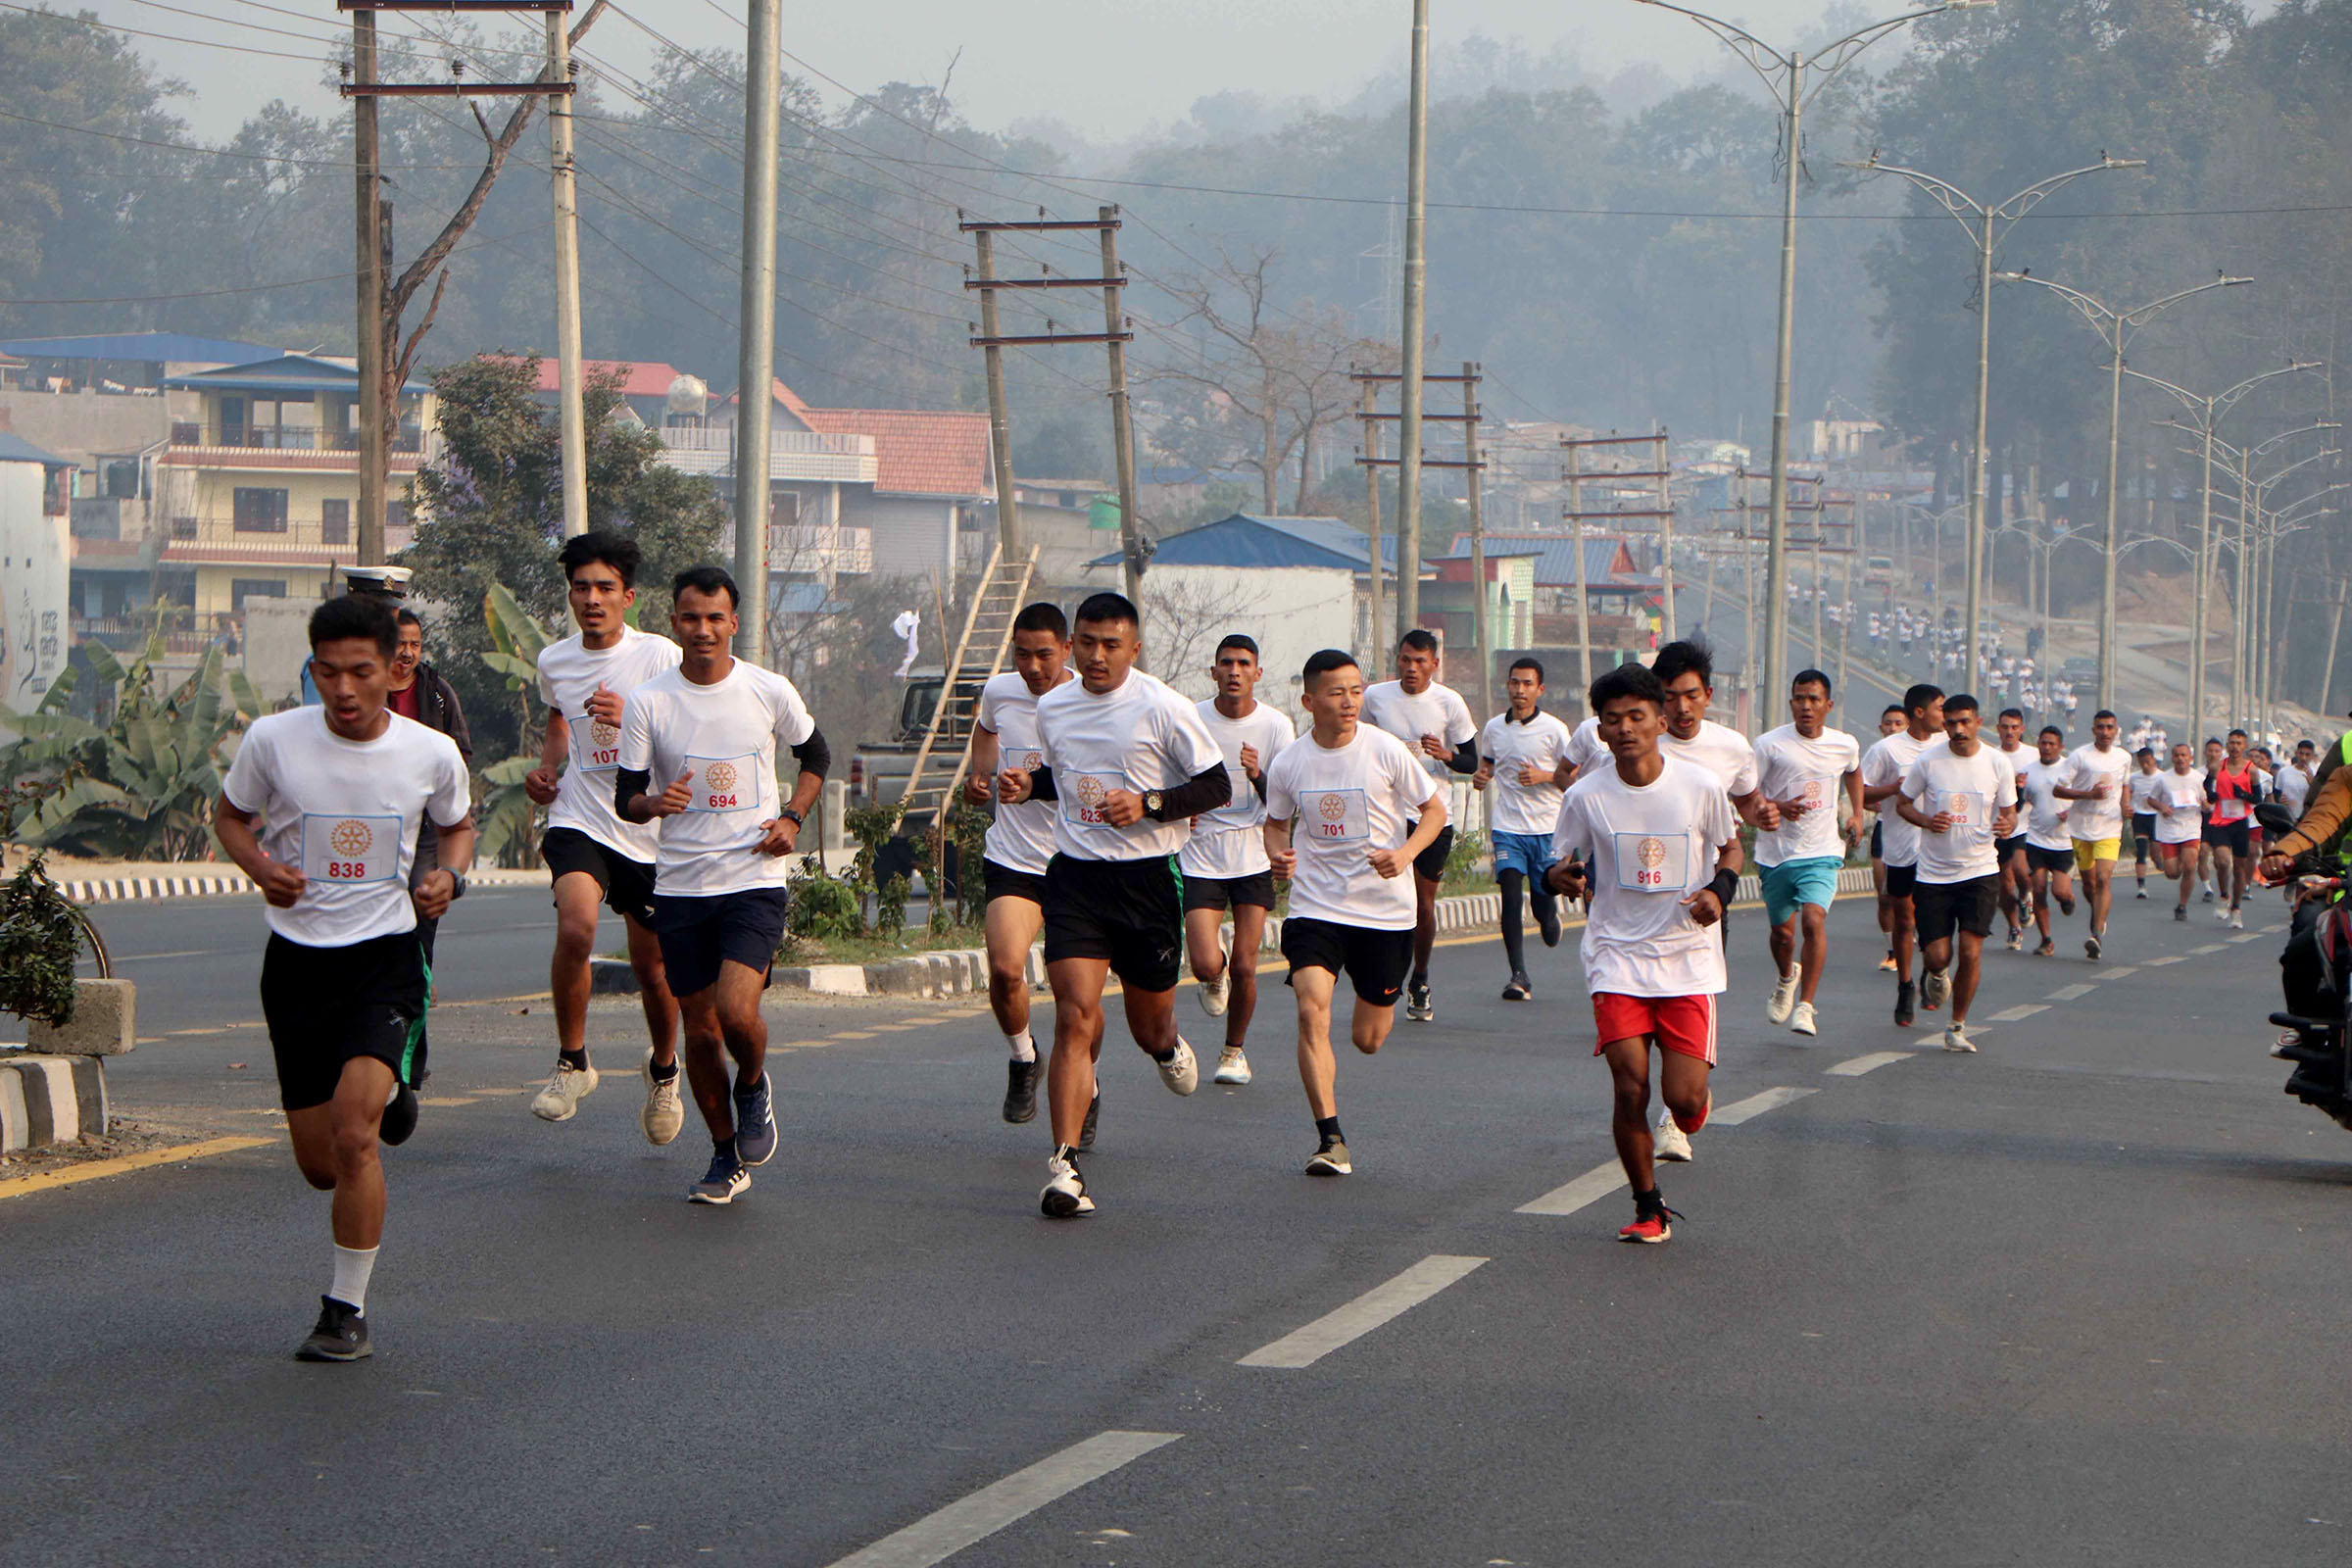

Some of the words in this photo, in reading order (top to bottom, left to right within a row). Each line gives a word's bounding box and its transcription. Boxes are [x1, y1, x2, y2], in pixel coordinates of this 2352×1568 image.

[592, 748, 619, 764] 107
[709, 794, 737, 808] 694
[1081, 808, 1102, 823] 823
[1322, 823, 1345, 836] 701
[329, 861, 366, 878] 838
[1638, 870, 1661, 885] 916
